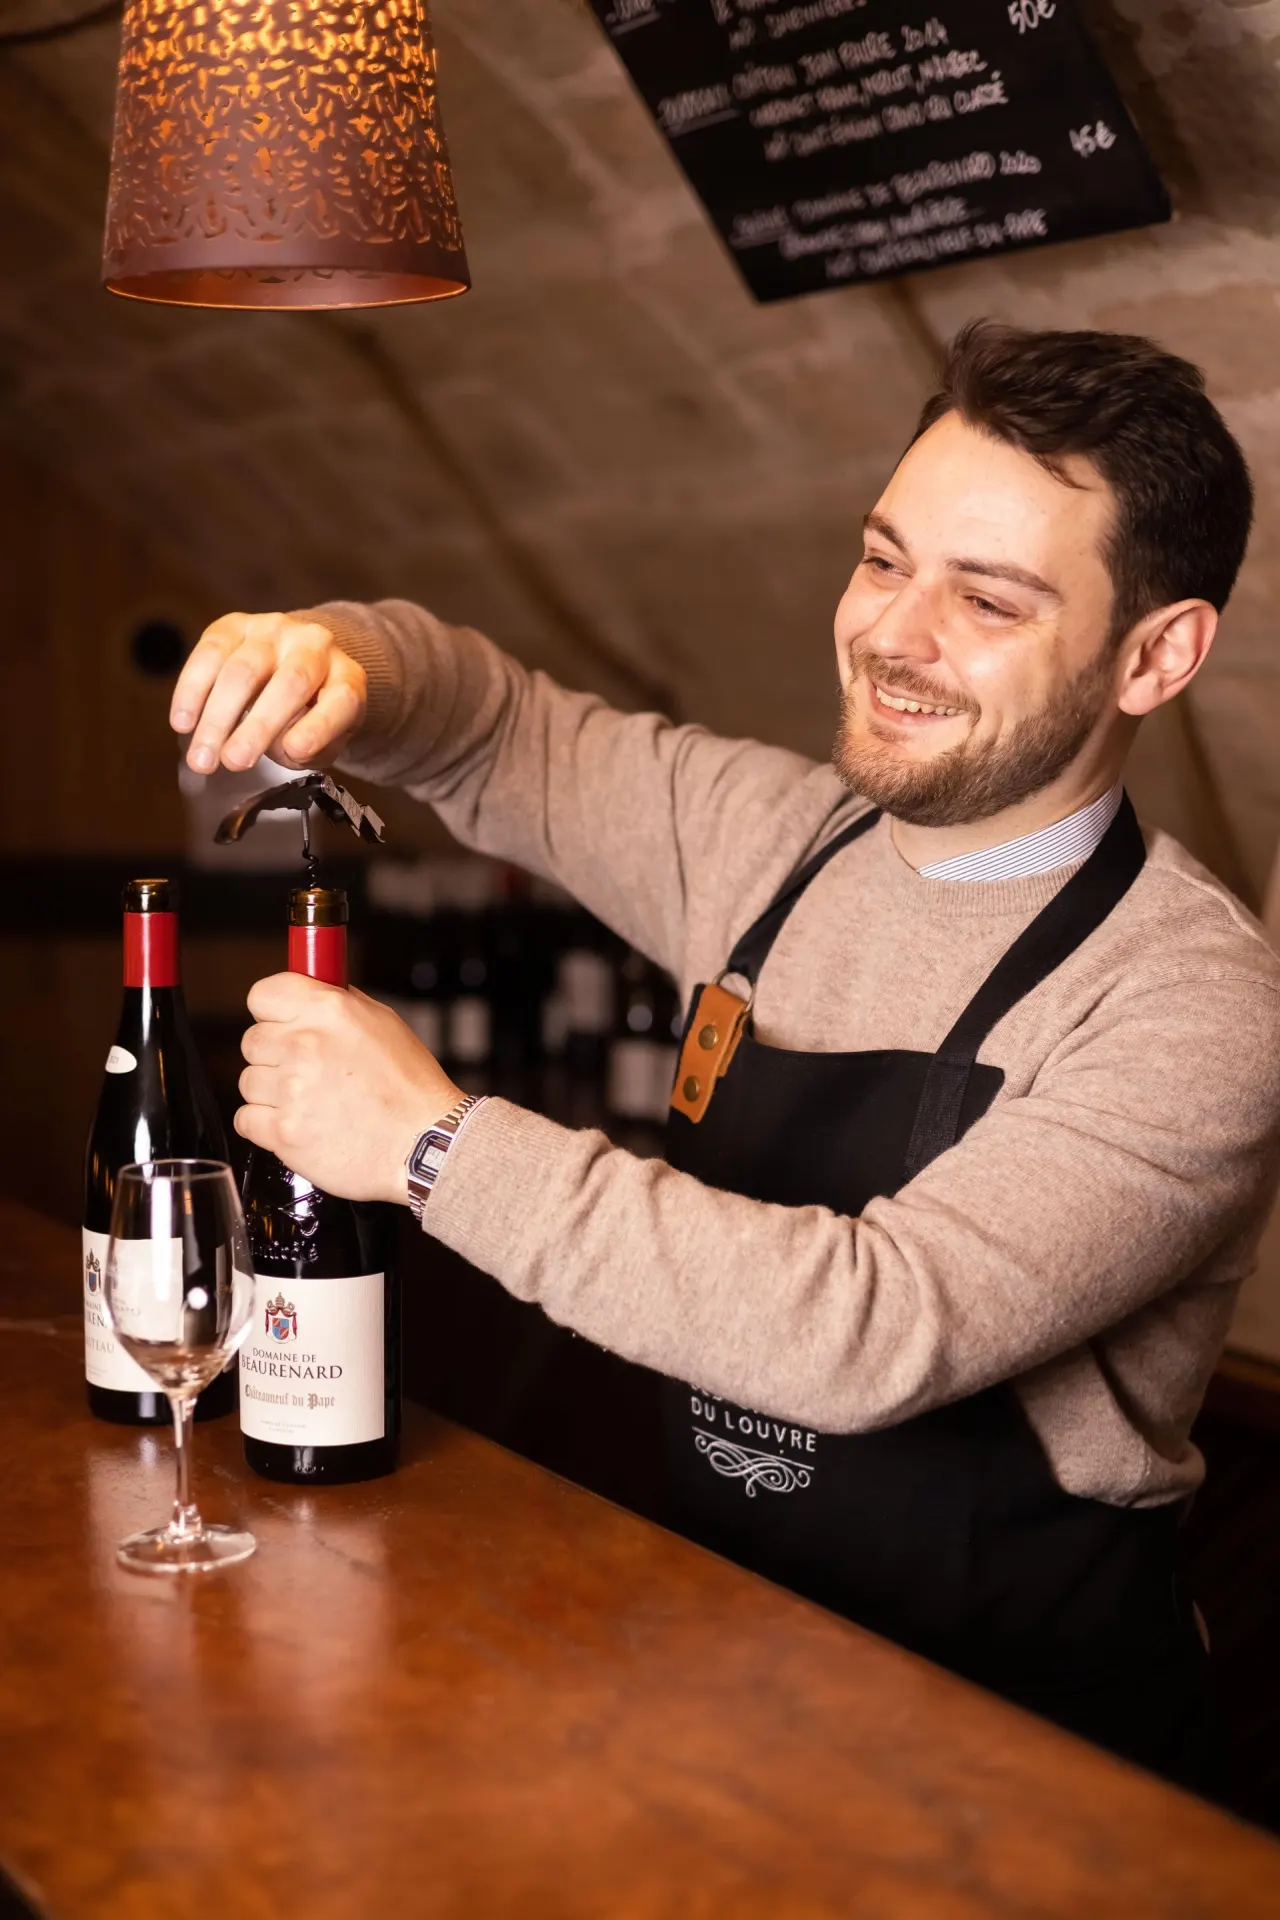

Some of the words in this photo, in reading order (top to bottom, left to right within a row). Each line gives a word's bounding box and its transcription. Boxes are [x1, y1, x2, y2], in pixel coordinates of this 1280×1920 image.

[1007, 0, 1057, 34] 50€
[241, 1354, 343, 1379] BEAURENARD
[253, 1347, 298, 1363] DOMAINE
[302, 1354, 317, 1363] DE
[292, 1394, 304, 1407] du
[307, 1393, 335, 1410] Pape
[691, 1396, 716, 1422] DU
[724, 1410, 817, 1452] LOUVRE
